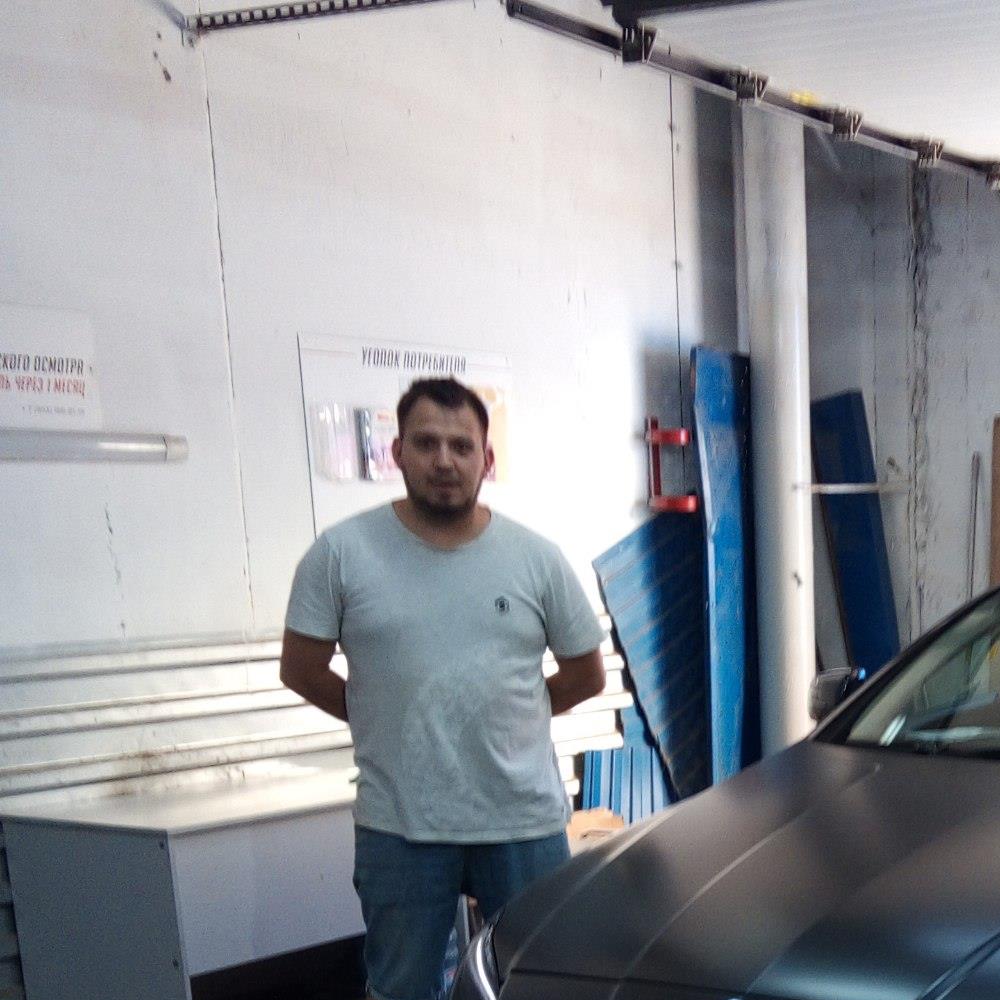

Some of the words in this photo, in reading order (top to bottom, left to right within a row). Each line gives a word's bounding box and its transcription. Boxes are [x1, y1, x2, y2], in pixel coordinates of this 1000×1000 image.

[0, 353, 30, 371] КОГО
[33, 355, 84, 376] ОСМОТРА
[361, 345, 400, 369] УГОЛОК
[403, 350, 466, 374] ПОТРЕБИТЕЛЯ
[15, 375, 44, 392] ЧЕРЕЗ
[54, 378, 86, 399] МЕСЯЦ
